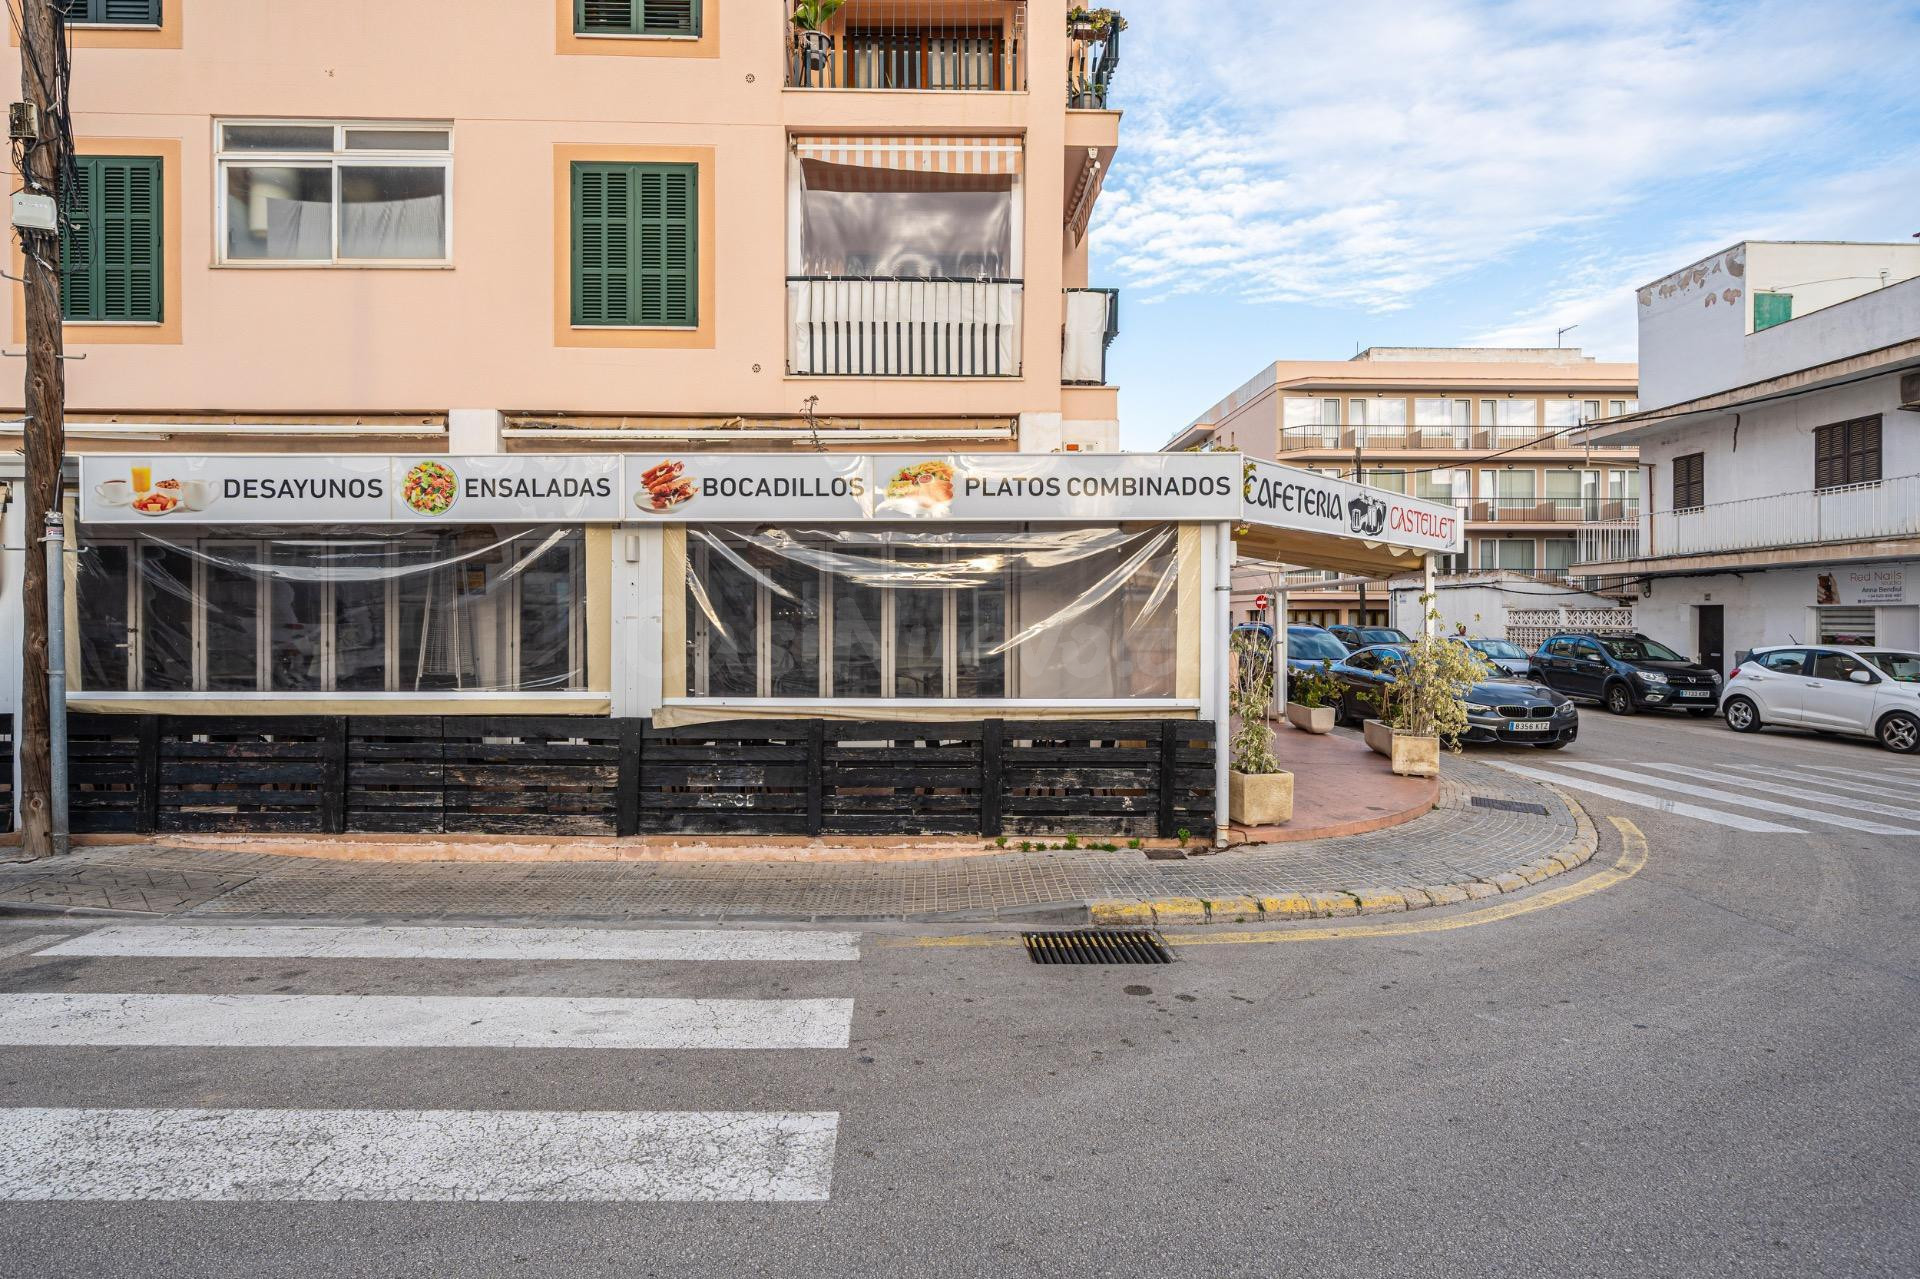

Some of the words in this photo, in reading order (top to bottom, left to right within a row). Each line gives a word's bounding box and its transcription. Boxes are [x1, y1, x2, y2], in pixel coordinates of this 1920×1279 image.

[224, 478, 383, 499] DESAYUNOS
[465, 477, 611, 498] ENSALADAS
[703, 477, 865, 498] BOCADILLOS
[965, 477, 1061, 497] PLATOS
[1067, 476, 1231, 497] COMBINADOS
[1244, 475, 1343, 521] CAFETERIA
[1390, 506, 1456, 541] CASTELLET
[1850, 572, 1871, 582] Red
[1874, 570, 1902, 580] Nails
[1515, 722, 1534, 730] 8356
